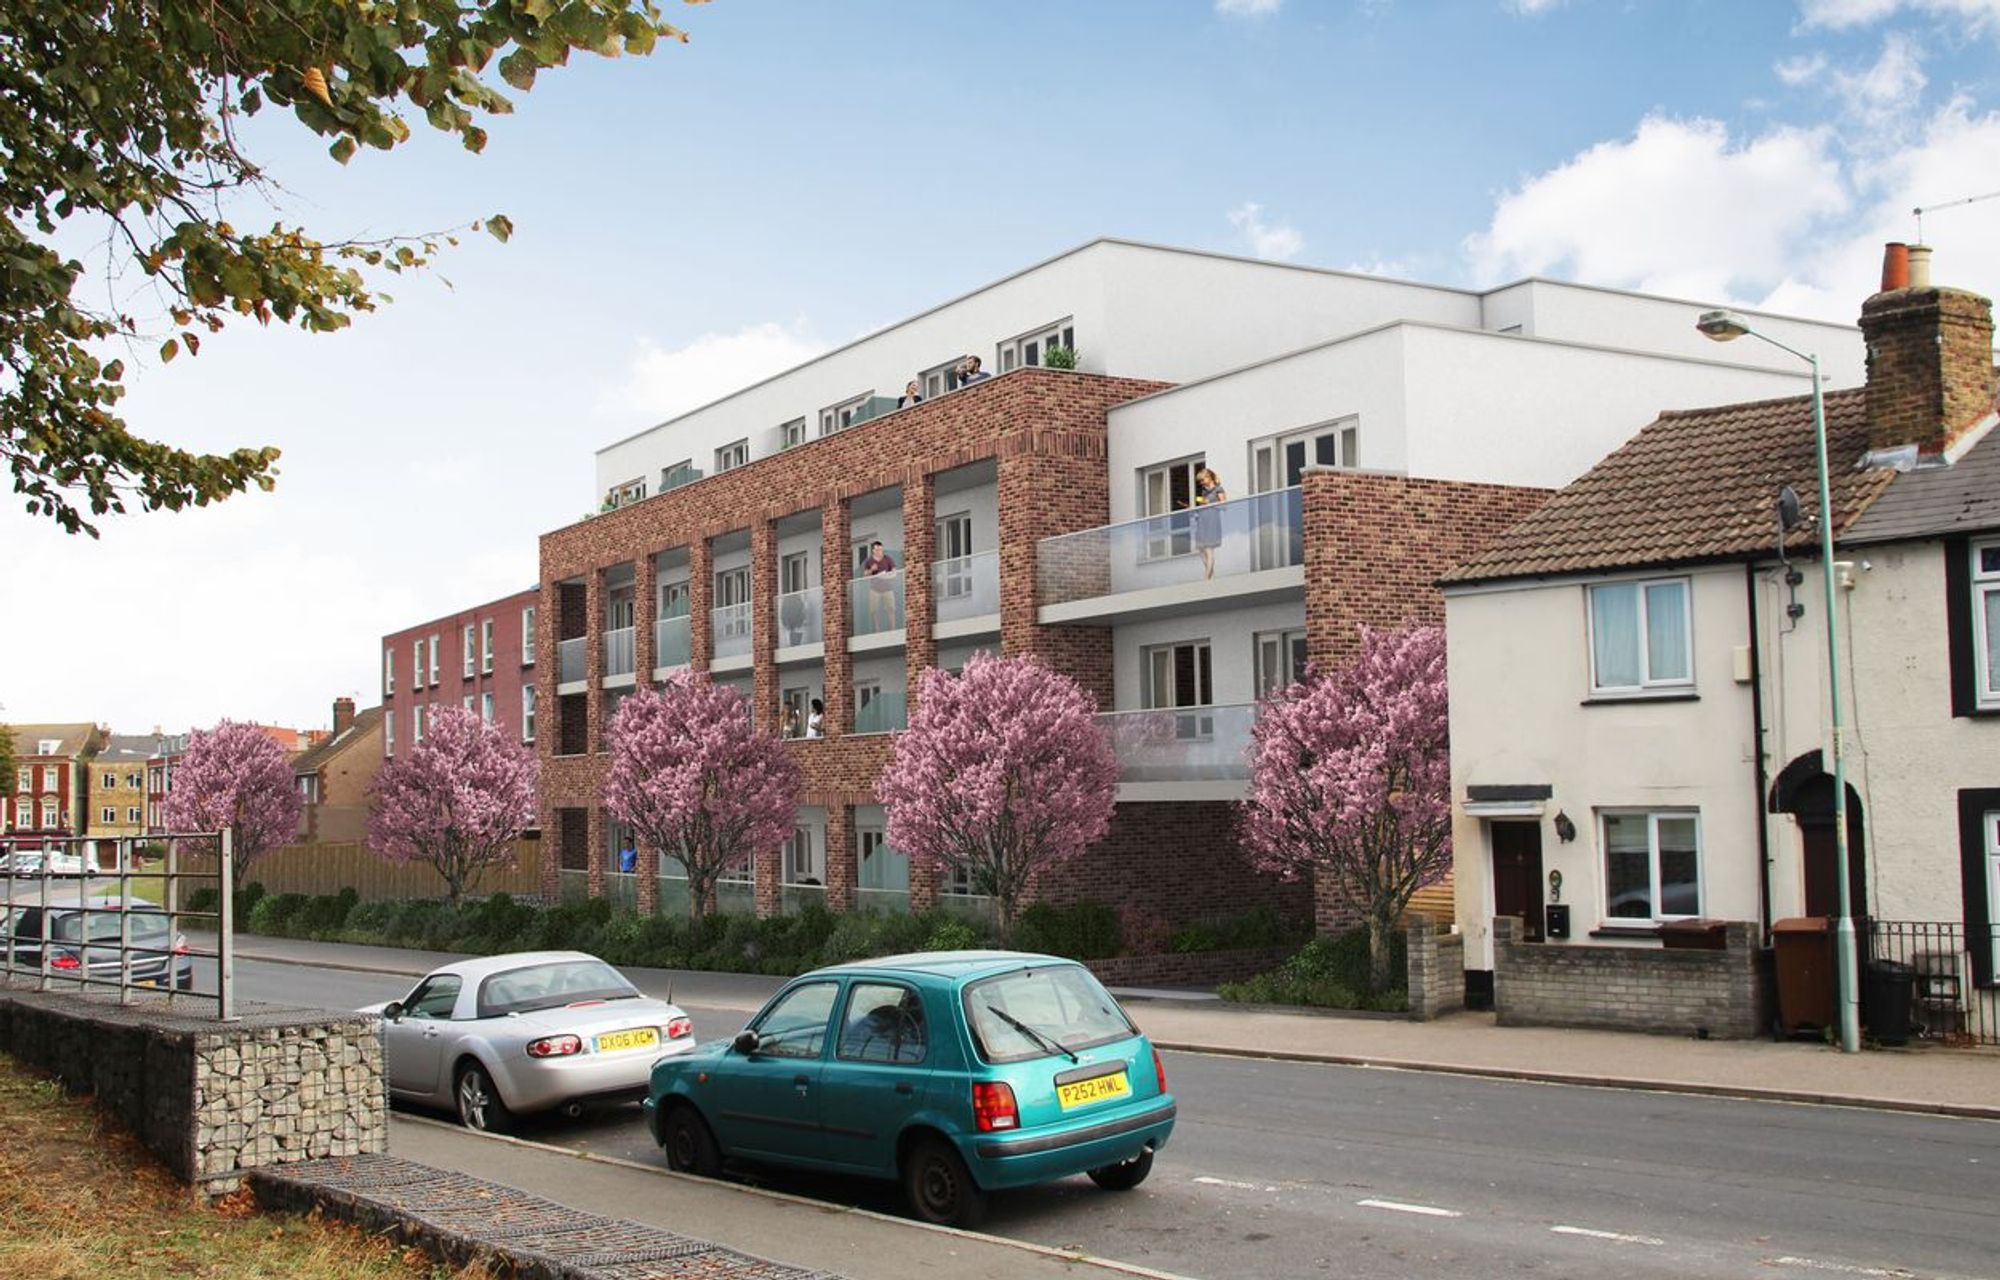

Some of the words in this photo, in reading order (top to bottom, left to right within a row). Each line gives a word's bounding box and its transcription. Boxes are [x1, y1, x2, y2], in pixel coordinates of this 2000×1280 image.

[600, 1034, 630, 1049] DX06
[1063, 1082, 1097, 1102] P252
[1098, 1078, 1122, 1095] HWL
